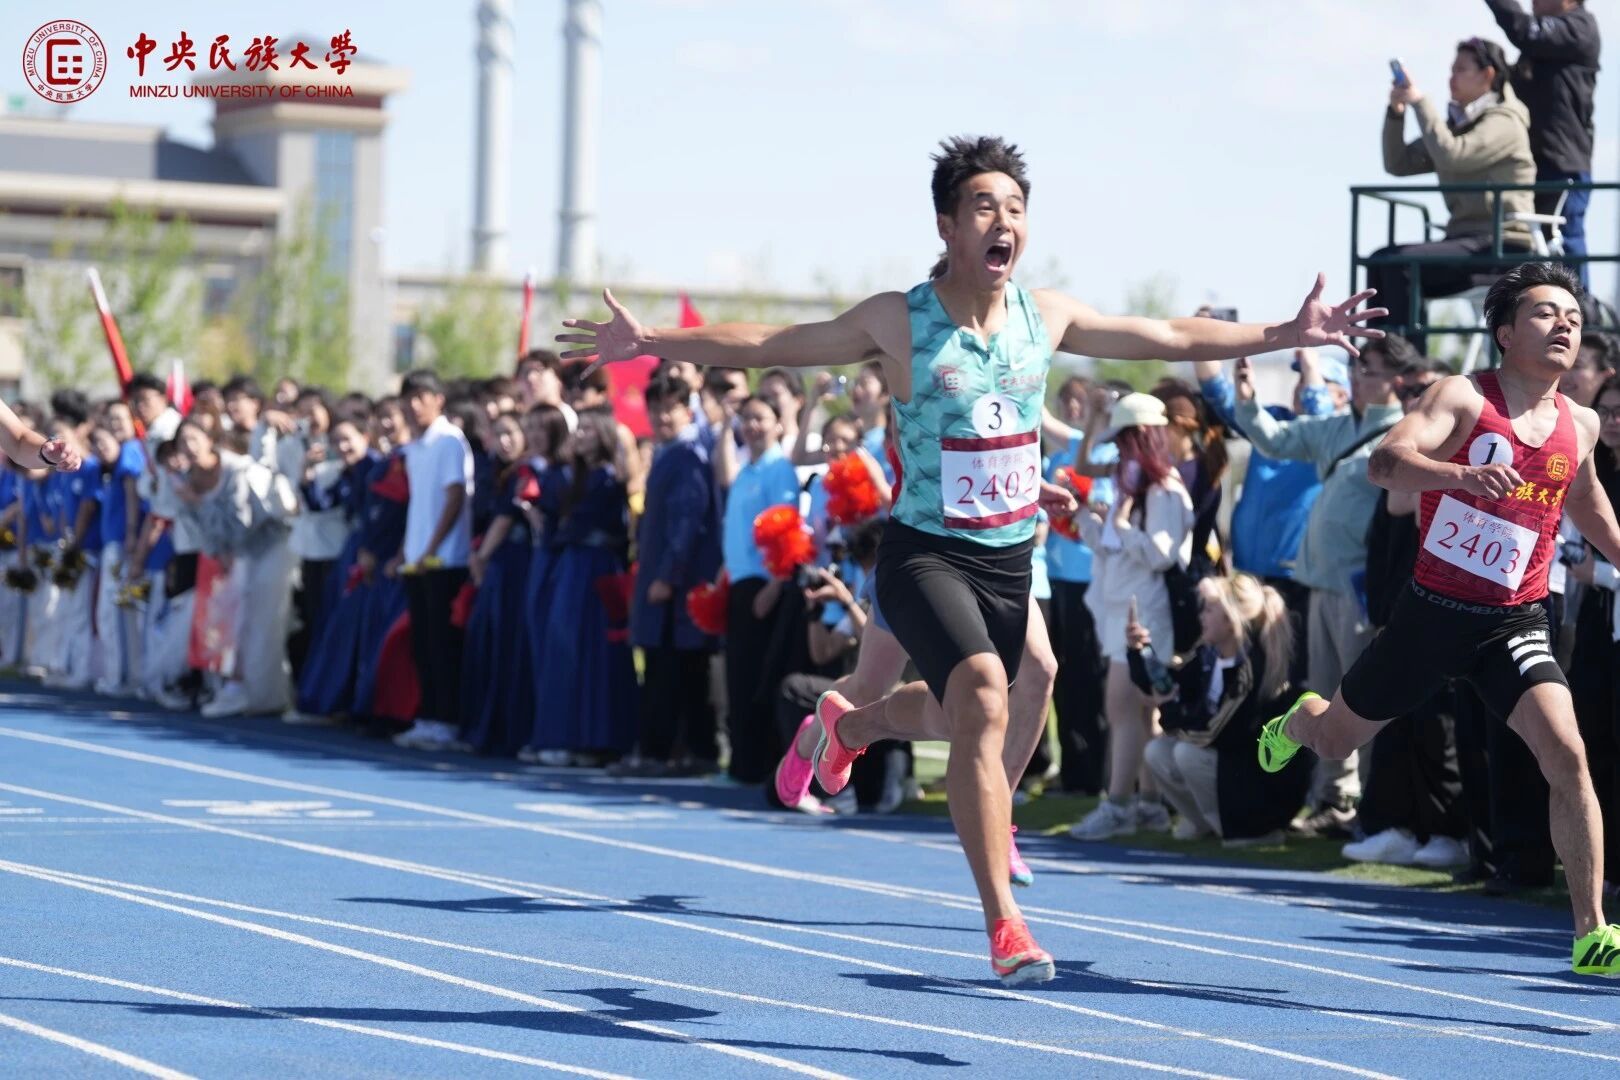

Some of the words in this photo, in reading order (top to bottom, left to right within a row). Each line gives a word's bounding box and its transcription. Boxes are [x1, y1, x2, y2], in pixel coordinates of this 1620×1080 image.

[988, 401, 1002, 430] 3
[1480, 442, 1499, 465] 1
[1463, 511, 1514, 541] 体育学院
[1437, 521, 1521, 574] 2403
